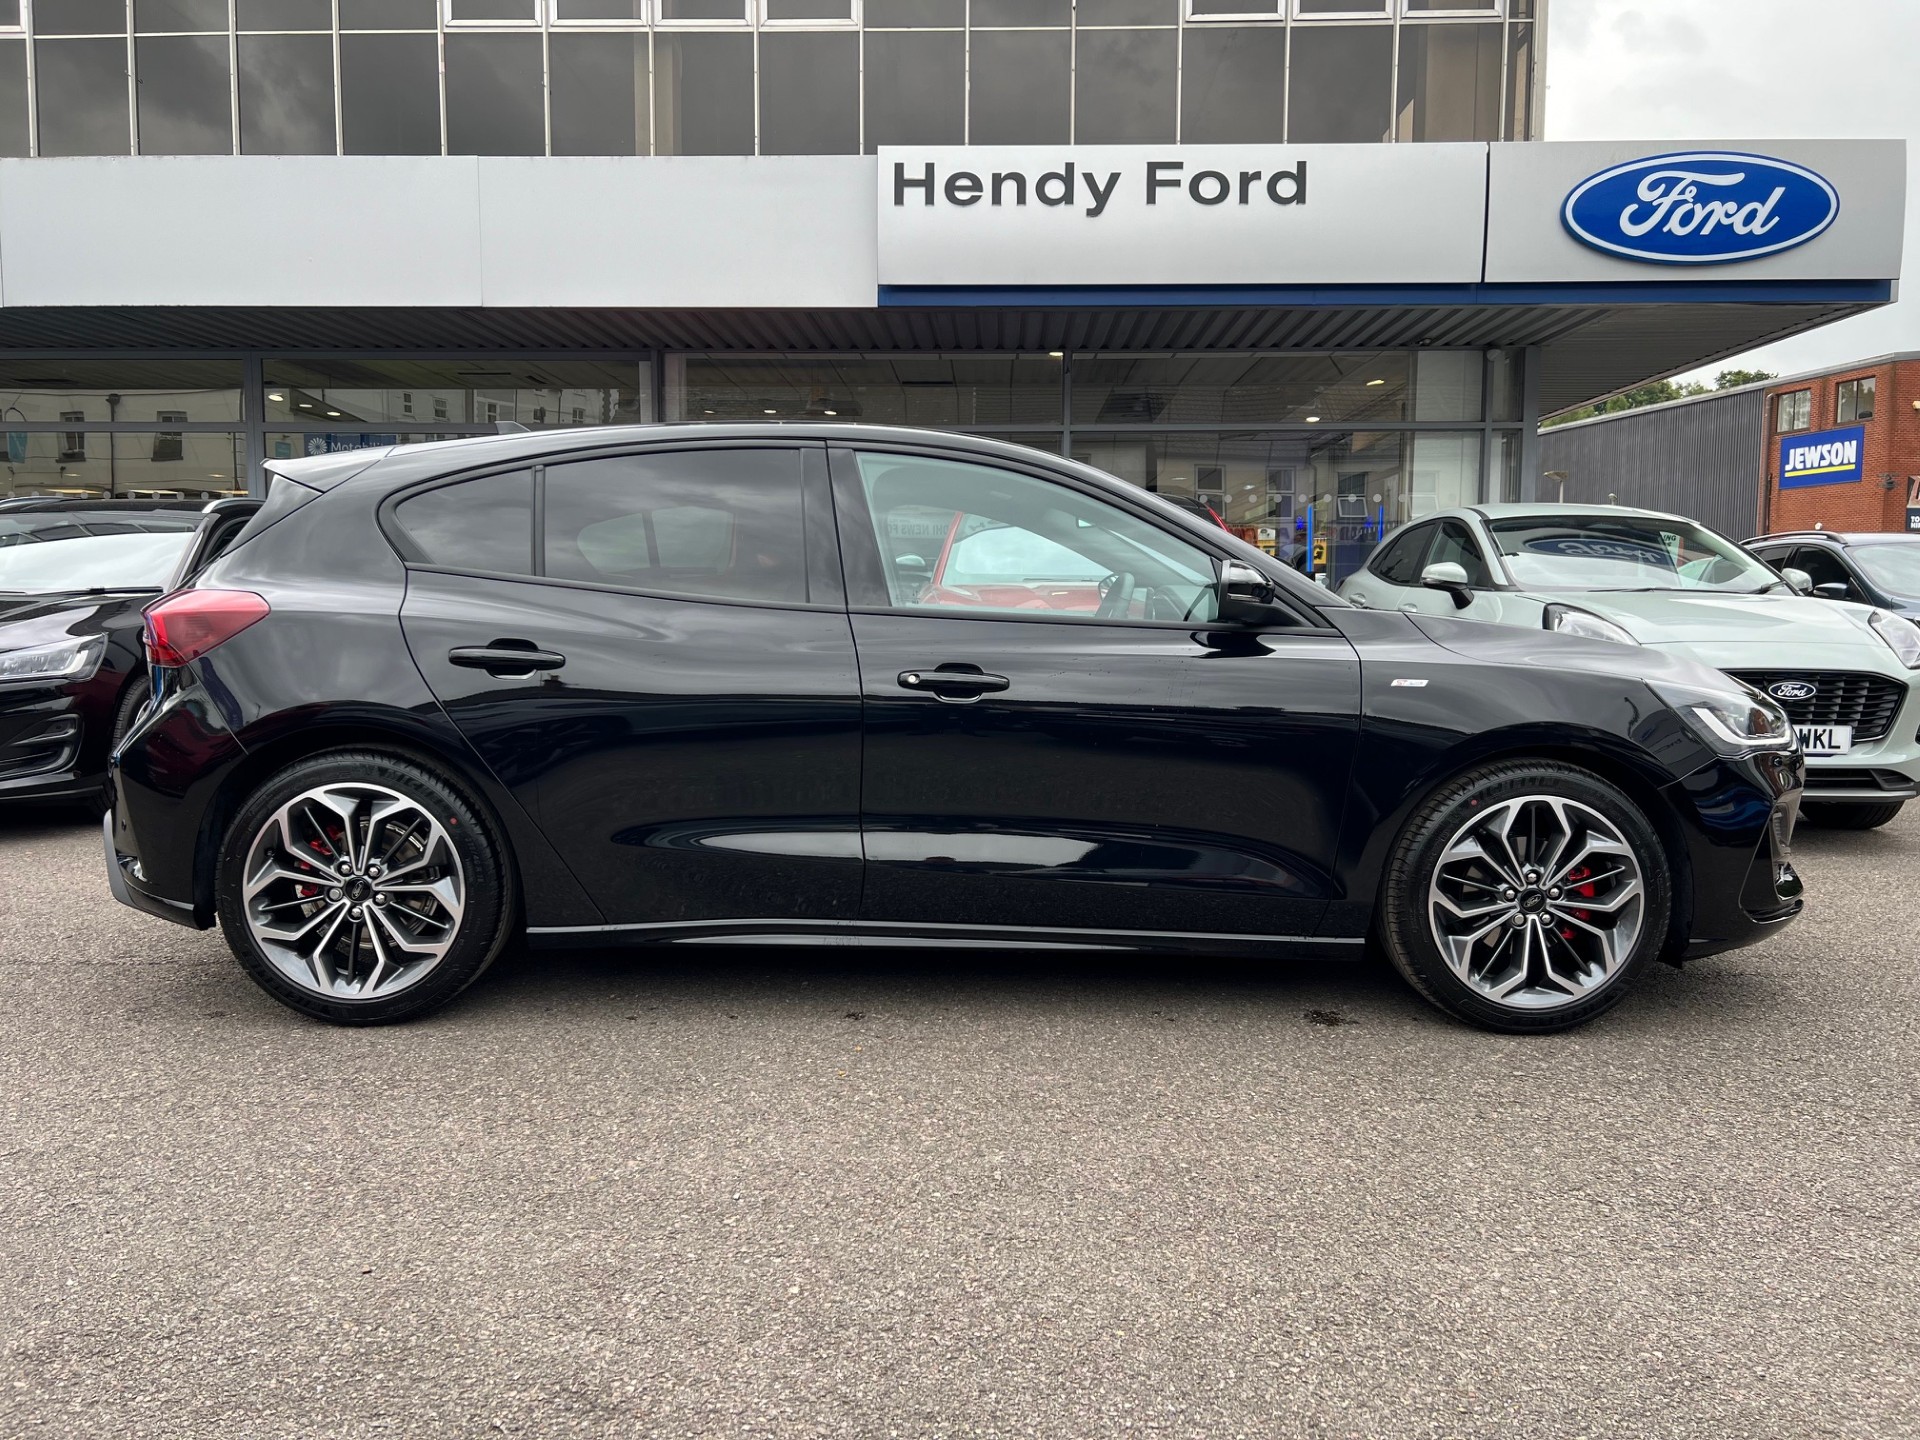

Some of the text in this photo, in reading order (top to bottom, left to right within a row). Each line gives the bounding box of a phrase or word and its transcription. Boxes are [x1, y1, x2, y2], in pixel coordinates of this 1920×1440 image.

[893, 161, 1307, 217] Hendy Ford
[1619, 170, 1786, 237] Ford
[1784, 440, 1857, 471] JEWSON
[1777, 684, 1808, 697] Ford
[1799, 728, 1841, 749] WKL
